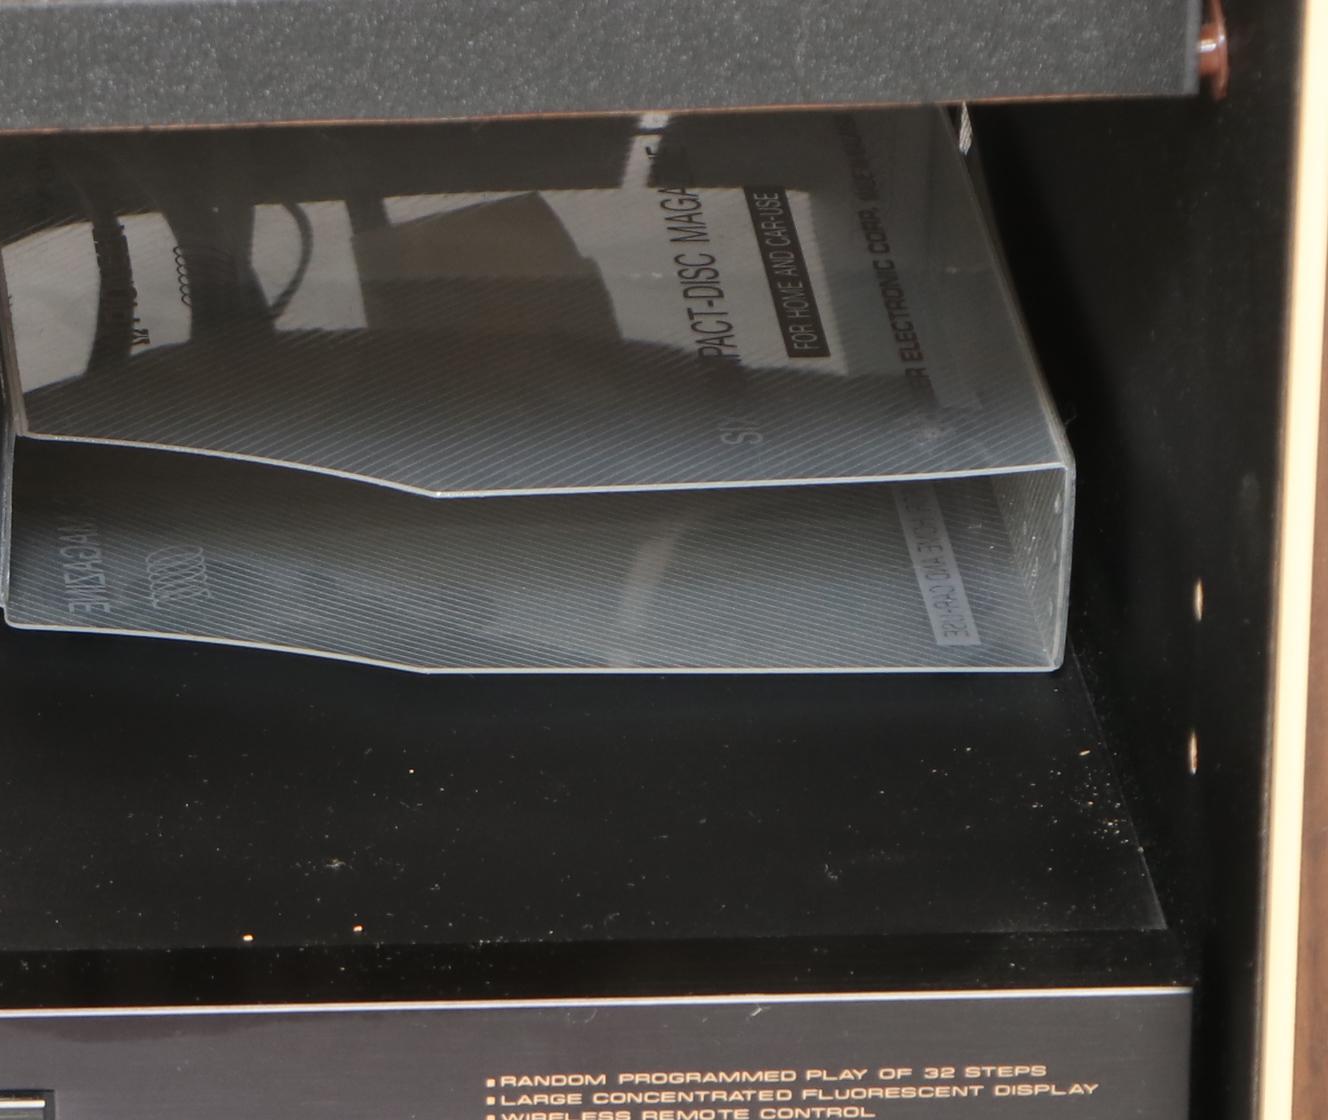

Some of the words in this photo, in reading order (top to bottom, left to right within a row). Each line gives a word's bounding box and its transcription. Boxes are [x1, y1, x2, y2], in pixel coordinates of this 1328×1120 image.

[753, 192, 791, 248] CAR-USE
[774, 248, 796, 277] AND
[780, 279, 811, 318] HOME
[793, 323, 816, 350] FOR
[500, 1074, 606, 1087] RANDOM
[618, 1070, 796, 1084] PROGRAMMED
[806, 1069, 867, 1081] PLAY
[879, 1068, 912, 1079] OF
[924, 1067, 955, 1079] 32
[964, 1065, 1046, 1078] STEPS
[501, 1093, 582, 1106] LARGE
[592, 1089, 792, 1105] CONCENTRATED
[801, 1085, 984, 1100] FLUORESCENT
[993, 1083, 1098, 1096] DISPLAY
[641, 1109, 749, 1120] REMOTE
[759, 1106, 875, 1120] CONTROL
